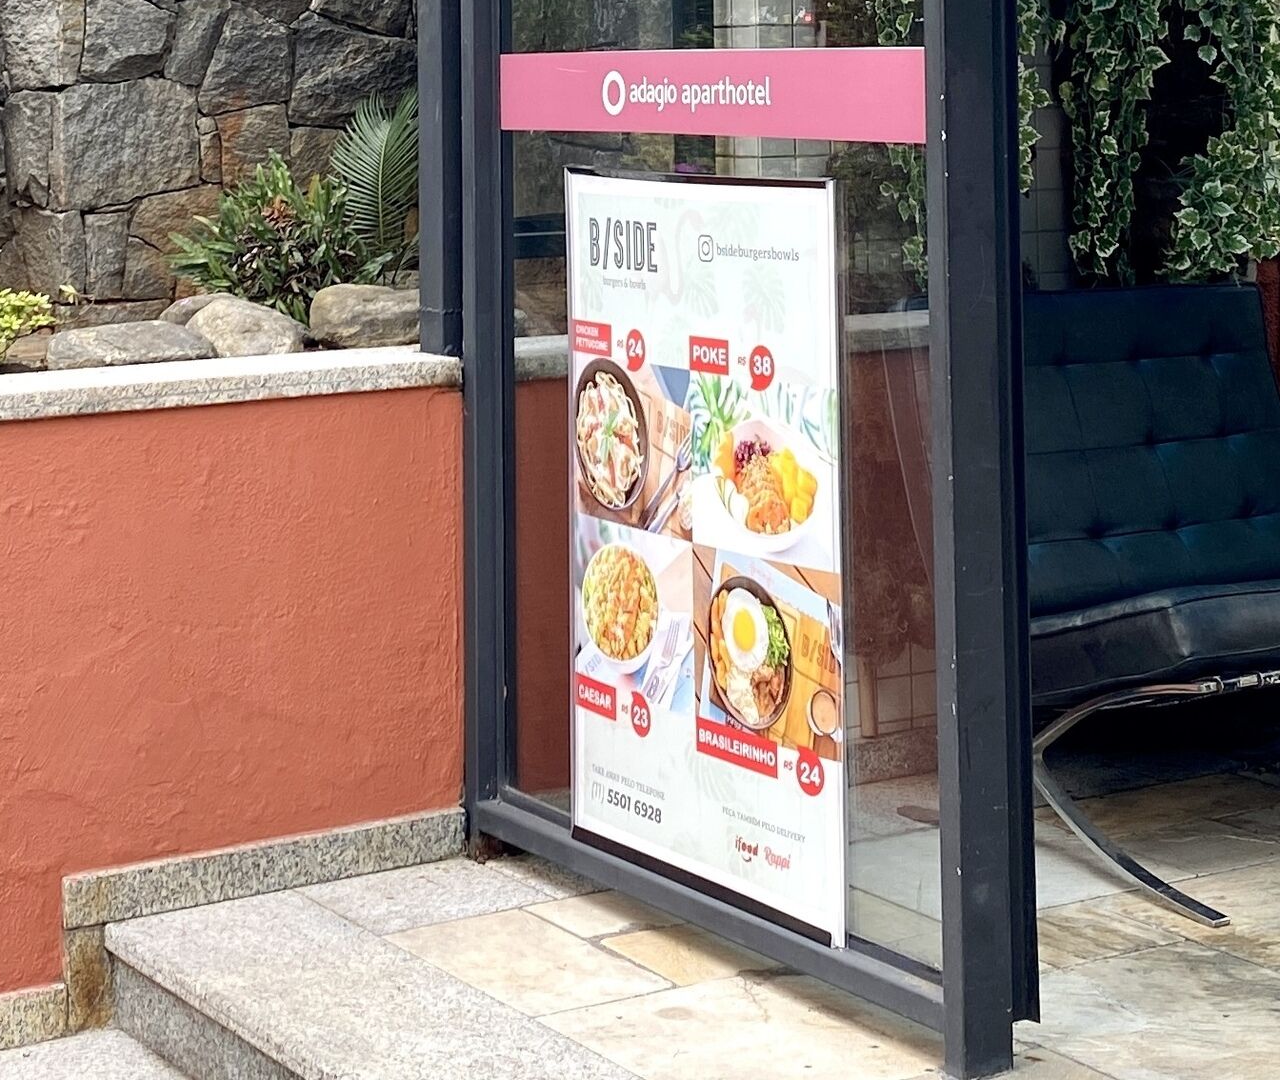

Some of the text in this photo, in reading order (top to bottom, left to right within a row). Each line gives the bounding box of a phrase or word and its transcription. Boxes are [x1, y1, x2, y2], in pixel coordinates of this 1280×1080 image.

[629, 76, 771, 113] adagio aparthotel
[588, 217, 658, 273] B/SIDE
[716, 242, 800, 261] bsideburgersbowls
[628, 338, 644, 358] 24
[692, 344, 727, 367] POKE
[753, 354, 772, 377] 38
[578, 683, 613, 712] CAESAR
[632, 705, 649, 729] 23
[698, 727, 777, 769] BRASILEIRINHO
[799, 760, 821, 788] 24
[606, 788, 632, 813] 5501
[634, 799, 662, 825] 6928
[763, 846, 791, 872] Rappi
